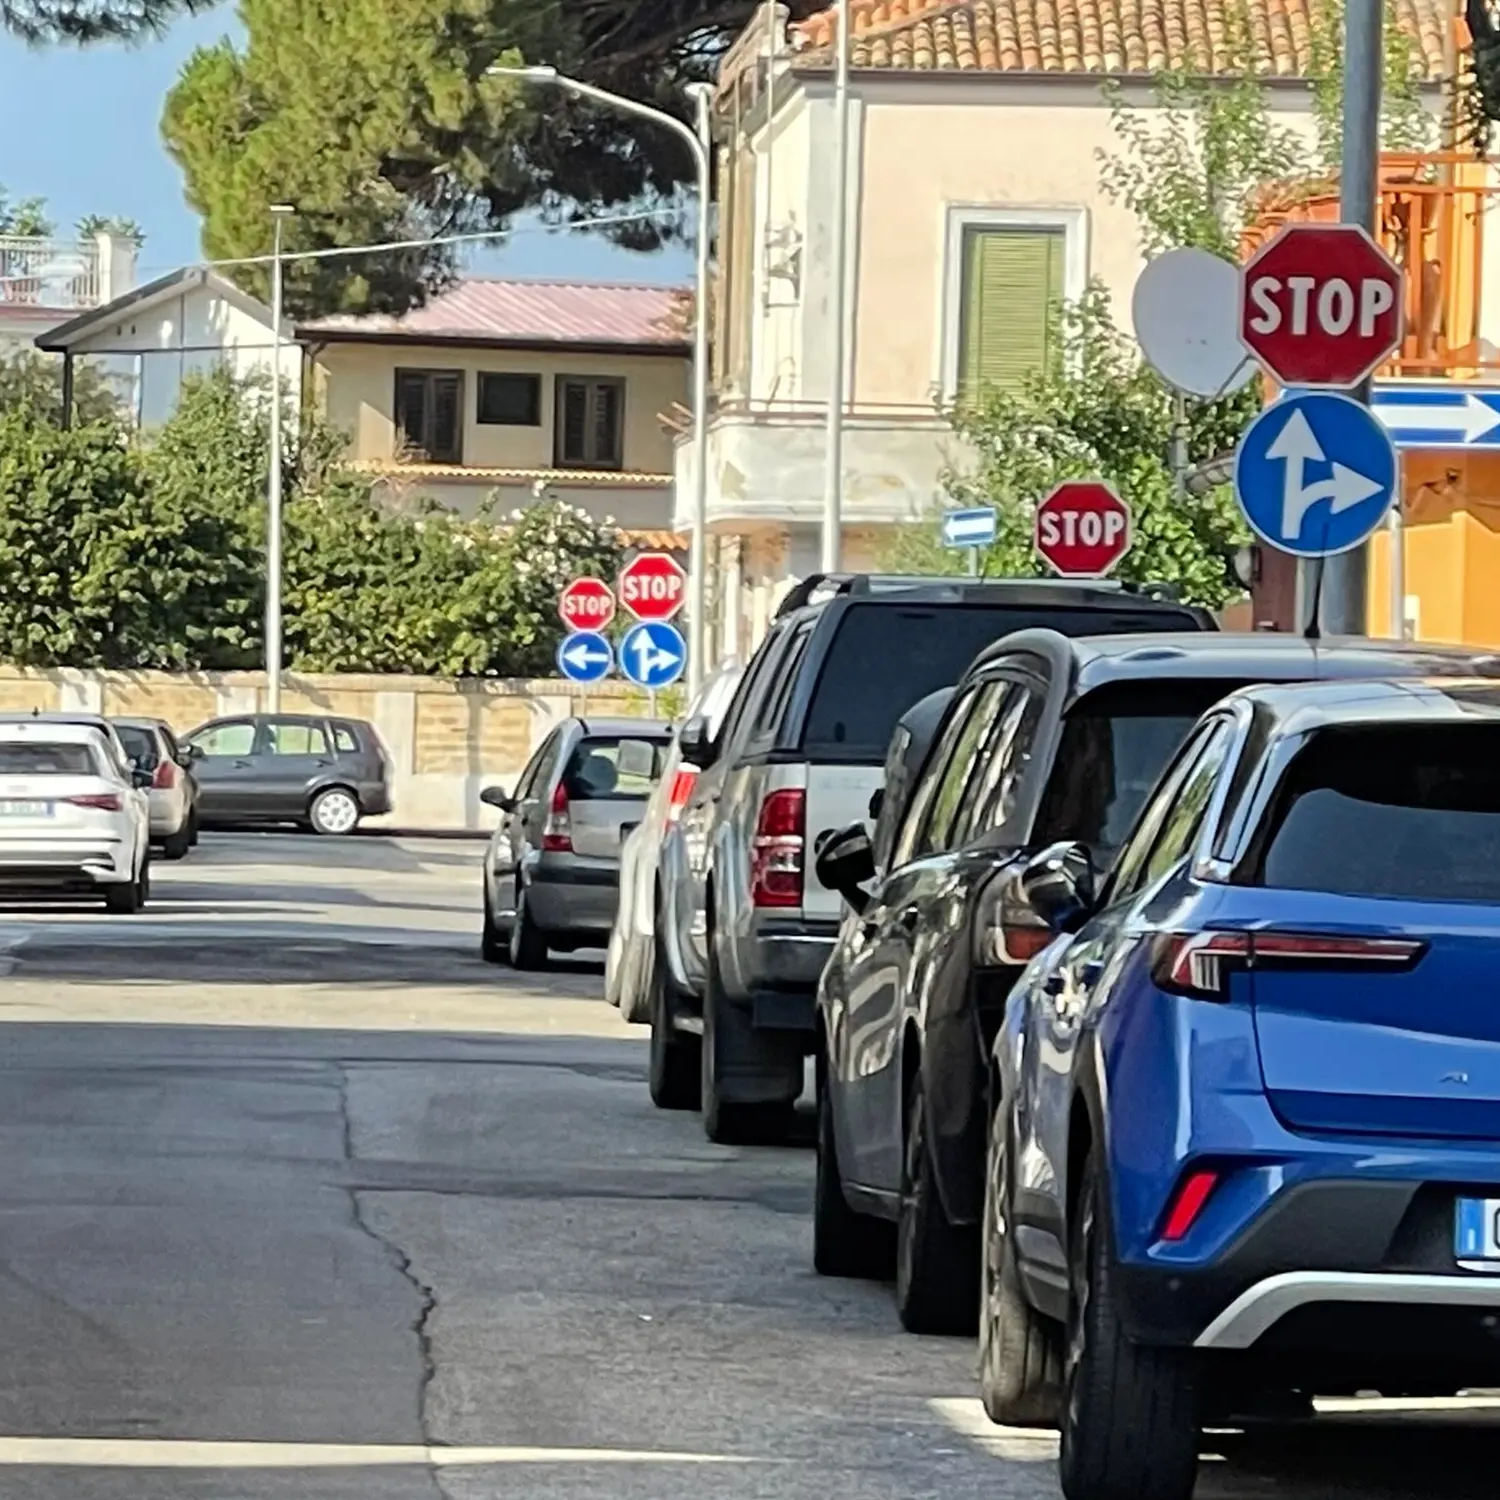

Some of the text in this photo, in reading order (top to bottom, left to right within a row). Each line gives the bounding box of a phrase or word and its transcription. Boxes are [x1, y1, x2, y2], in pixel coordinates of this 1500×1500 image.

[1250, 276, 1394, 337] STOP
[1041, 511, 1125, 547] STOP
[625, 574, 682, 601] STOP
[565, 594, 611, 616] STOP
